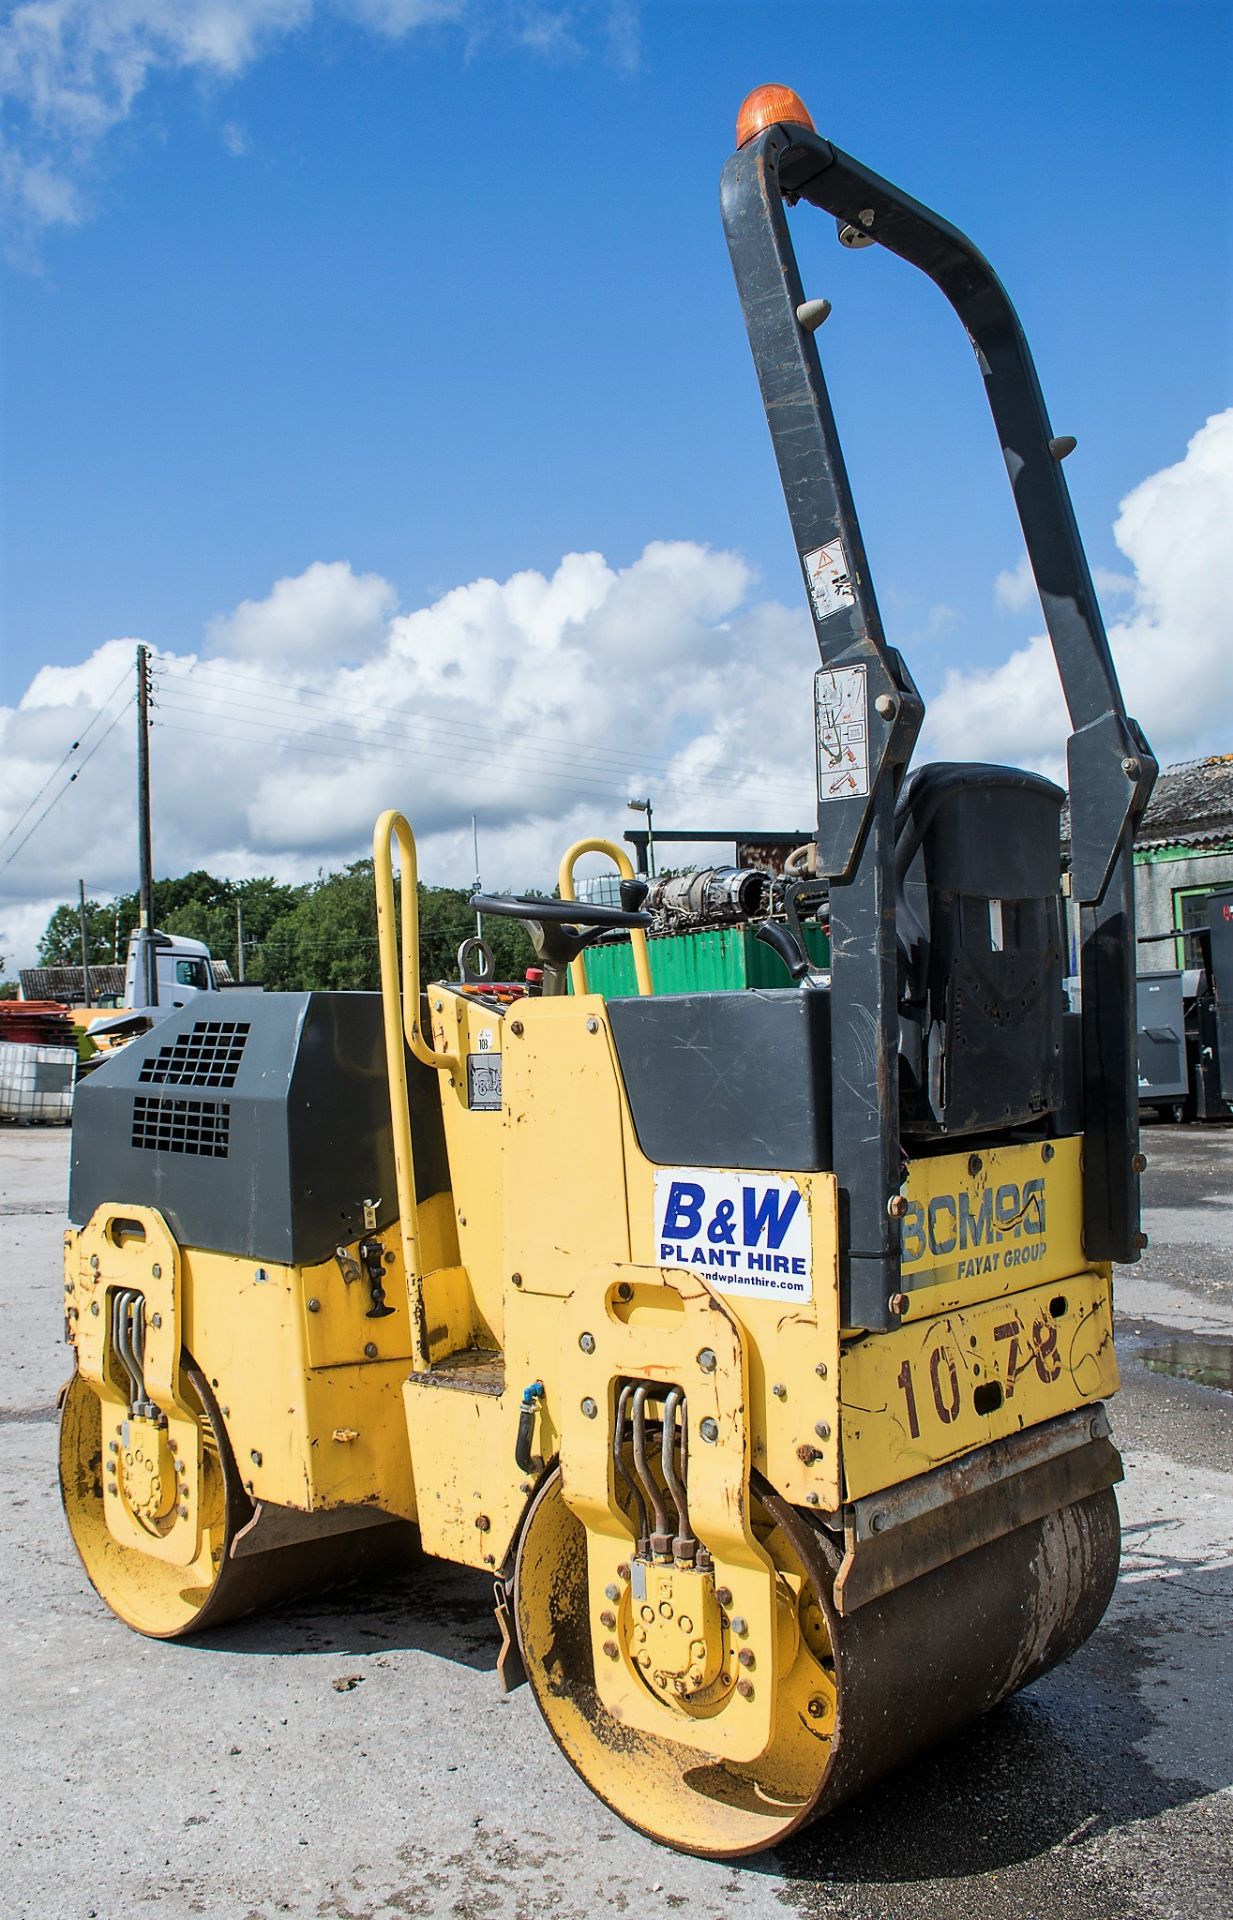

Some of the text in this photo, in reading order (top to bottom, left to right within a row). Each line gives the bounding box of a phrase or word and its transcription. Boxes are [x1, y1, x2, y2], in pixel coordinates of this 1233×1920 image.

[661, 1181, 802, 1250] B&W
[901, 1177, 1046, 1264] BOMAG
[660, 1243, 807, 1276] PLANT HIRE
[957, 1241, 1047, 1280] FAYAT GROUP
